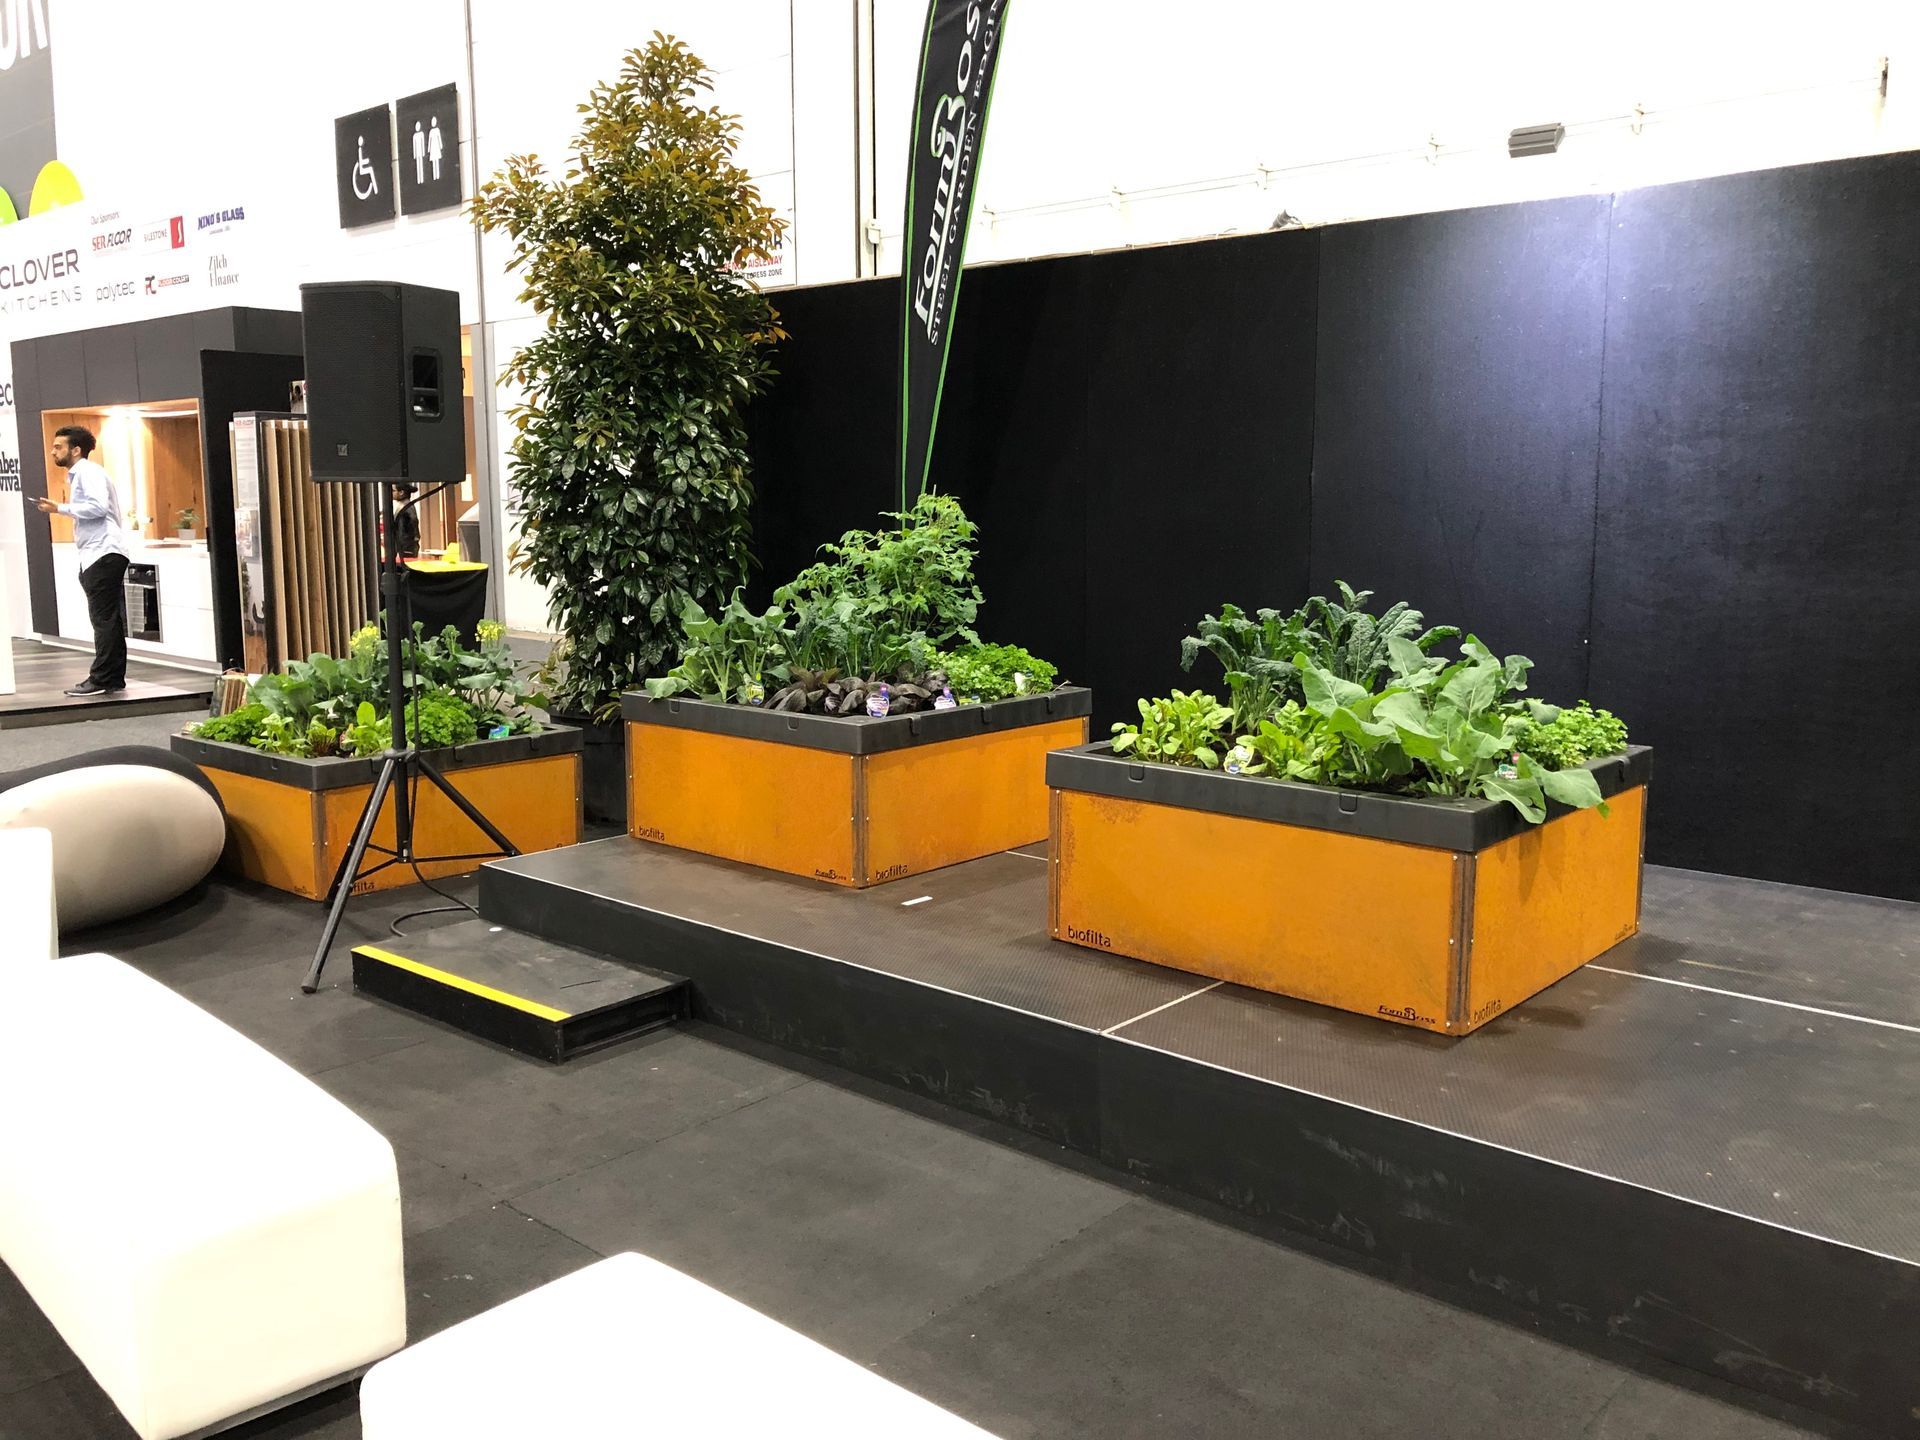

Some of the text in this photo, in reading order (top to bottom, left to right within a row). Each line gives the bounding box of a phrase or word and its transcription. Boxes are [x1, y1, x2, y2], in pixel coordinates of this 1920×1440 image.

[914, 0, 983, 341] FormBos
[222, 206, 245, 222] GLASS
[931, 254, 952, 345] STEEL
[948, 109, 977, 244] GARDEN
[0, 248, 80, 290] CLOVER
[0, 285, 82, 314] KITCHENS
[96, 279, 136, 303] polytec
[639, 825, 665, 841] biofilta
[875, 863, 908, 881] biofilta
[1067, 925, 1112, 948] biofilta
